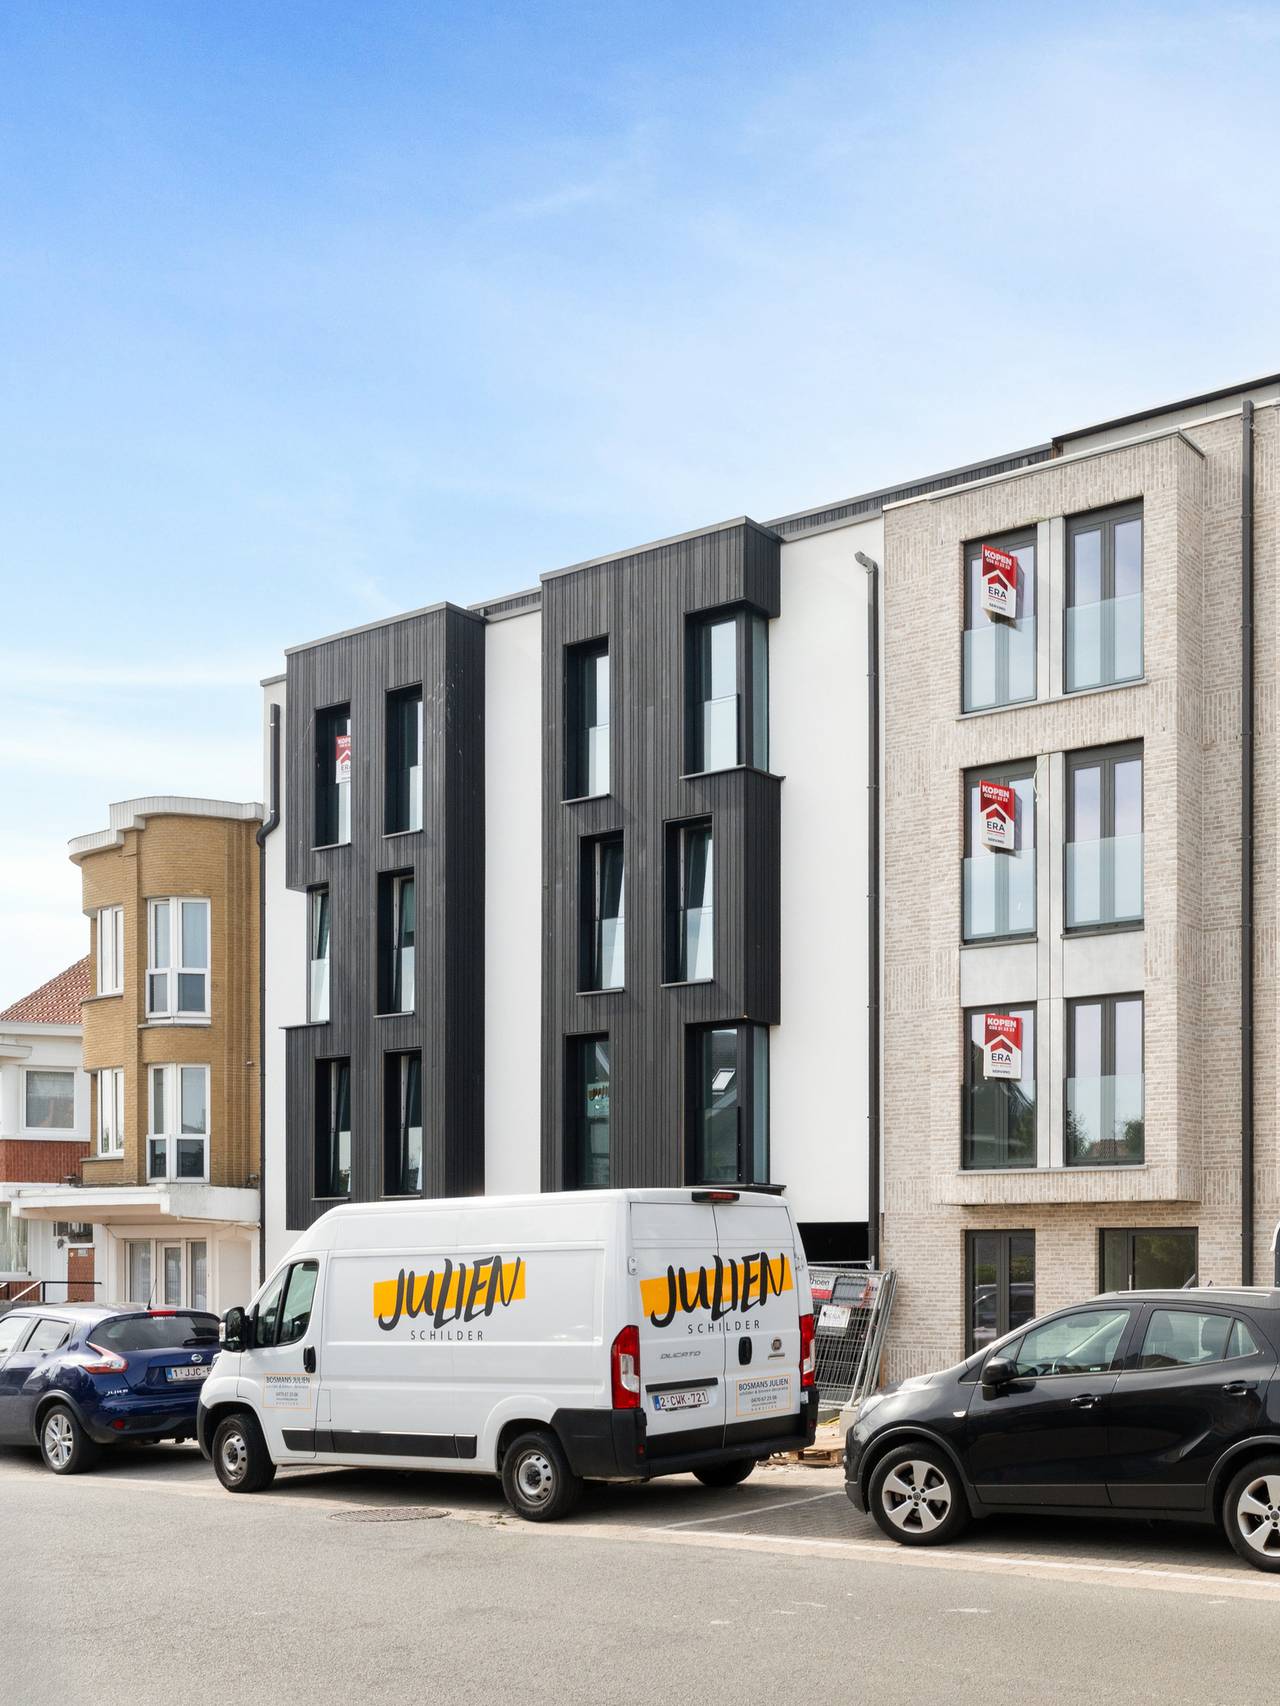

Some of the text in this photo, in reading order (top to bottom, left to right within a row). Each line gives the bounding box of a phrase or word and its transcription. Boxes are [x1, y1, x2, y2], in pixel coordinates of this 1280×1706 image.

[984, 548, 1012, 566] KOPEN
[988, 586, 1007, 599] ERA
[982, 785, 1010, 798] KOPEN
[986, 820, 1006, 832] ERA
[987, 1017, 1017, 1028] KOPEN
[991, 1053, 1012, 1062] ERA
[378, 1255, 521, 1331] JULIEN
[650, 1252, 785, 1328] JULIEN
[688, 1320, 760, 1334] SCHILDER
[410, 1330, 484, 1341] SCHILDER
[660, 1350, 701, 1360] DUCATO
[266, 1376, 311, 1384] BOSMANS JULIEN
[738, 1378, 789, 1391] BOSMANS JULIEN
